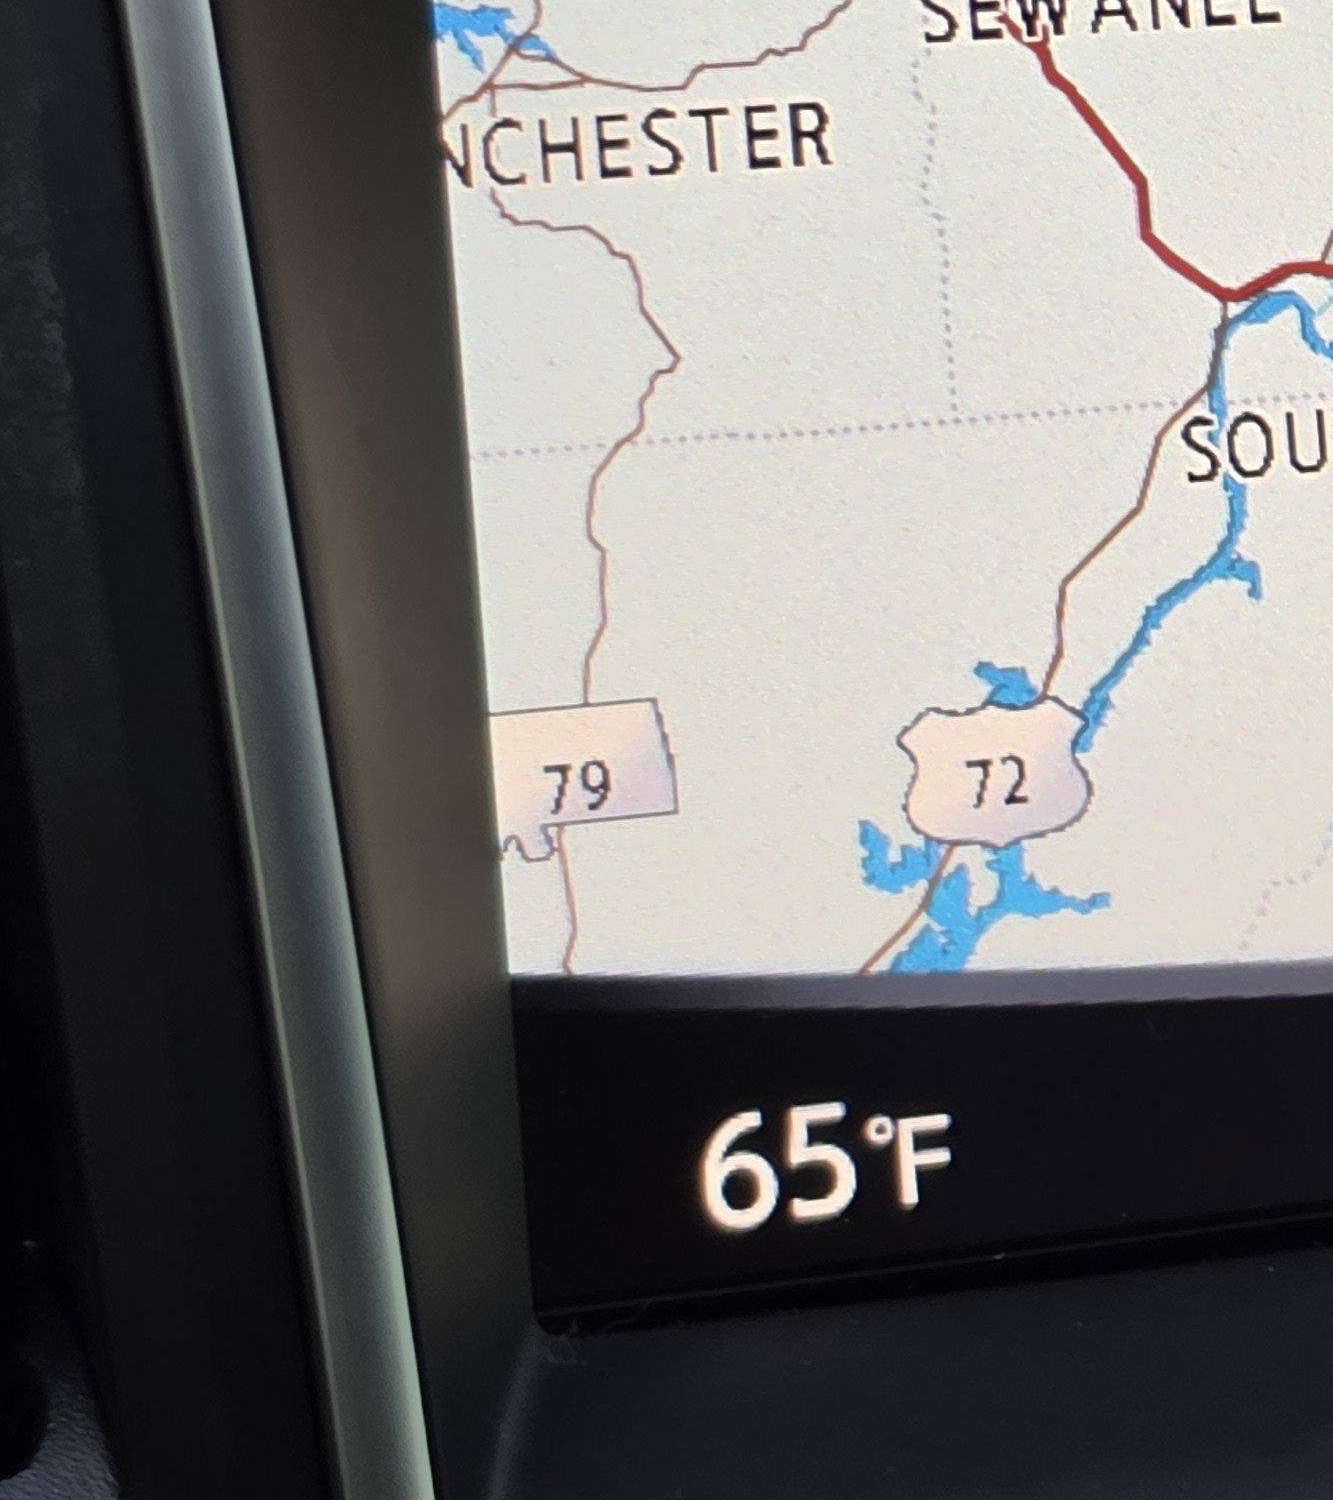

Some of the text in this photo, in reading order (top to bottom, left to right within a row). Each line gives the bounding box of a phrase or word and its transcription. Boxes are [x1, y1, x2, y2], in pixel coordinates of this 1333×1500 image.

[544, 761, 611, 814] 79
[965, 756, 1029, 808] 72
[700, 1101, 952, 1230] 65°F
